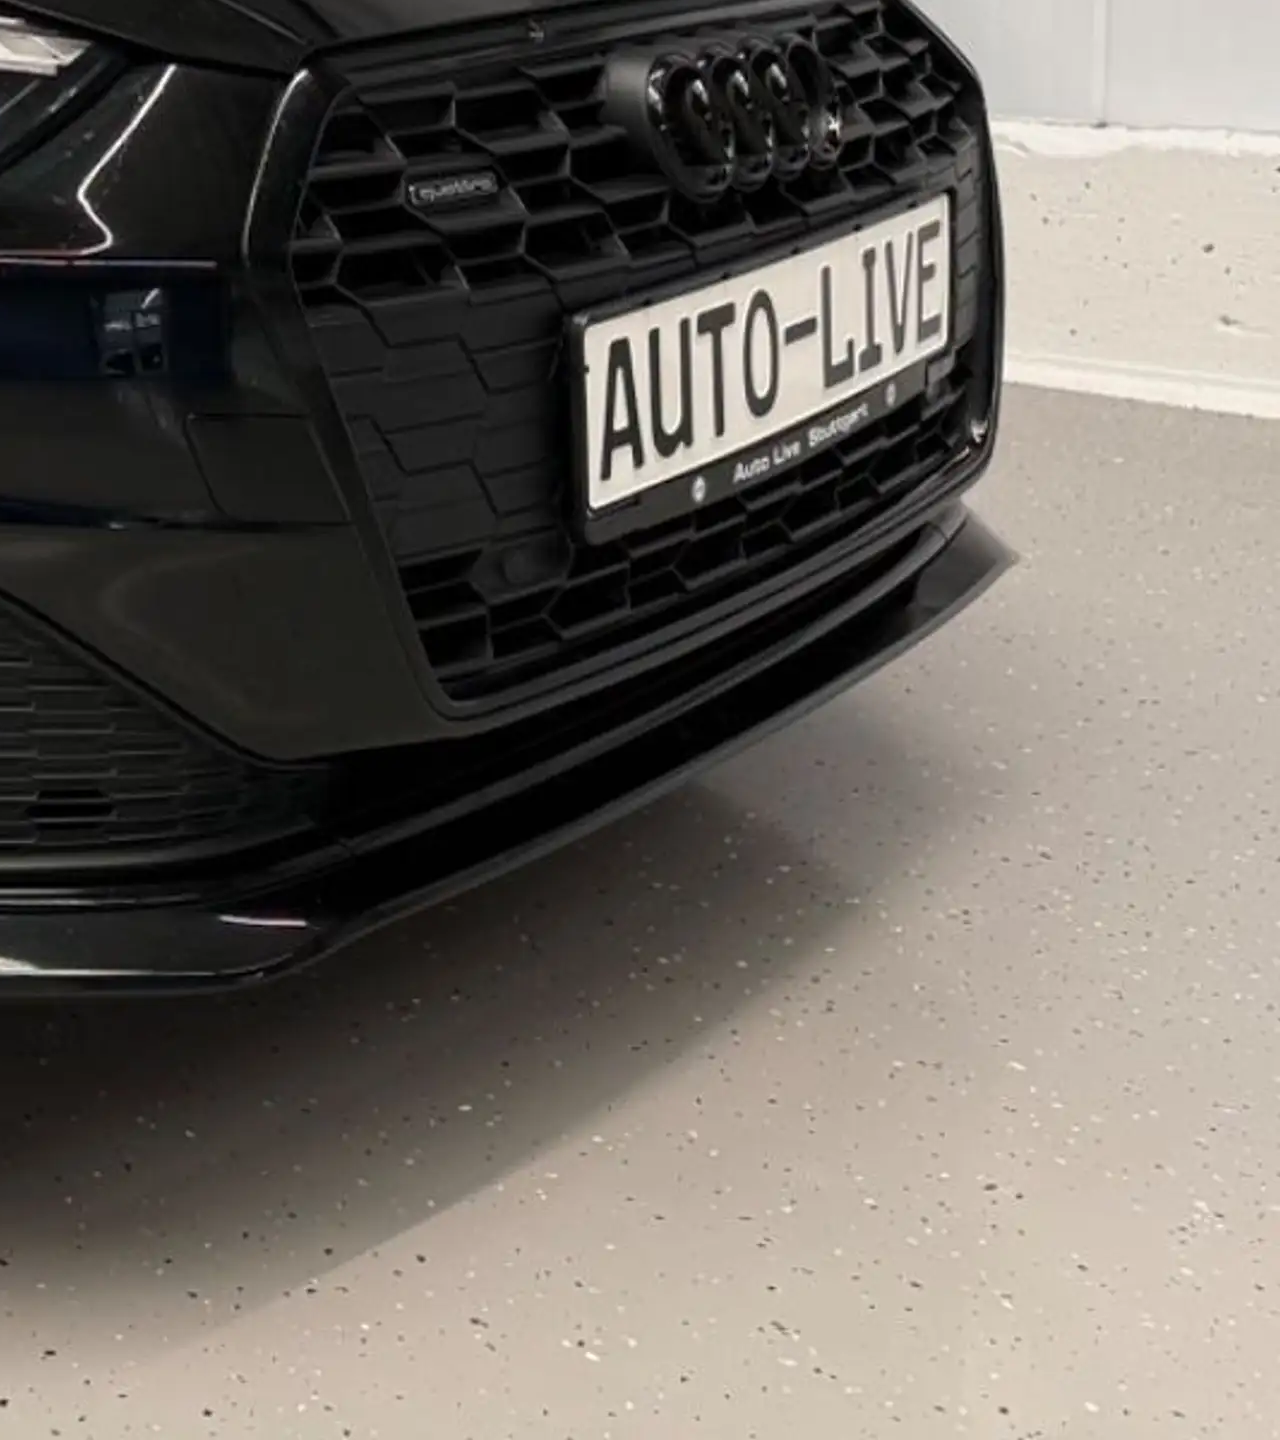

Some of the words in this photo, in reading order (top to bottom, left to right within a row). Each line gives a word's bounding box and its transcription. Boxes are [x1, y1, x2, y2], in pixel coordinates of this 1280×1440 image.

[599, 218, 941, 482] AUTO-LIVE
[732, 455, 771, 484] Auto
[772, 441, 802, 465] Live
